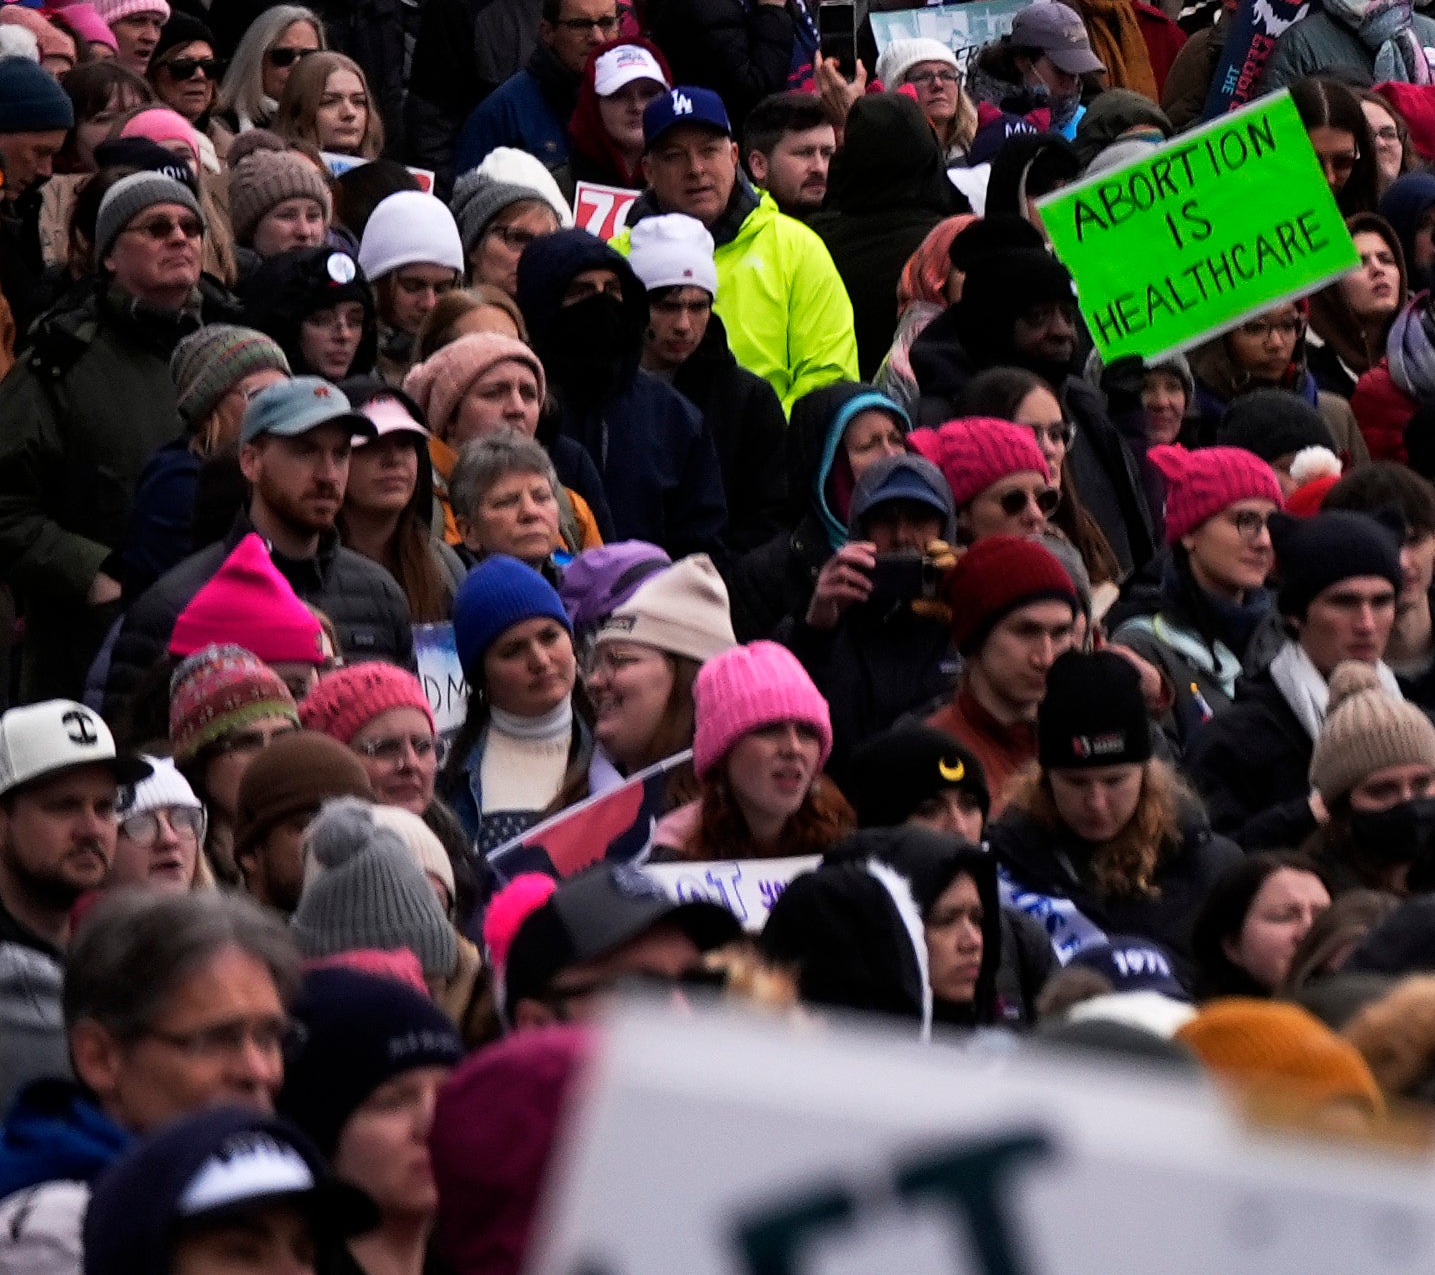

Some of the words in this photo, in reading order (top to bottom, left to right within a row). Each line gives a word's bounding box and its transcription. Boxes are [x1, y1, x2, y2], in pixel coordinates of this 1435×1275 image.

[1073, 114, 1278, 244] ABORTION
[1164, 199, 1215, 250] IS
[1092, 208, 1331, 346] HEALTHCARE
